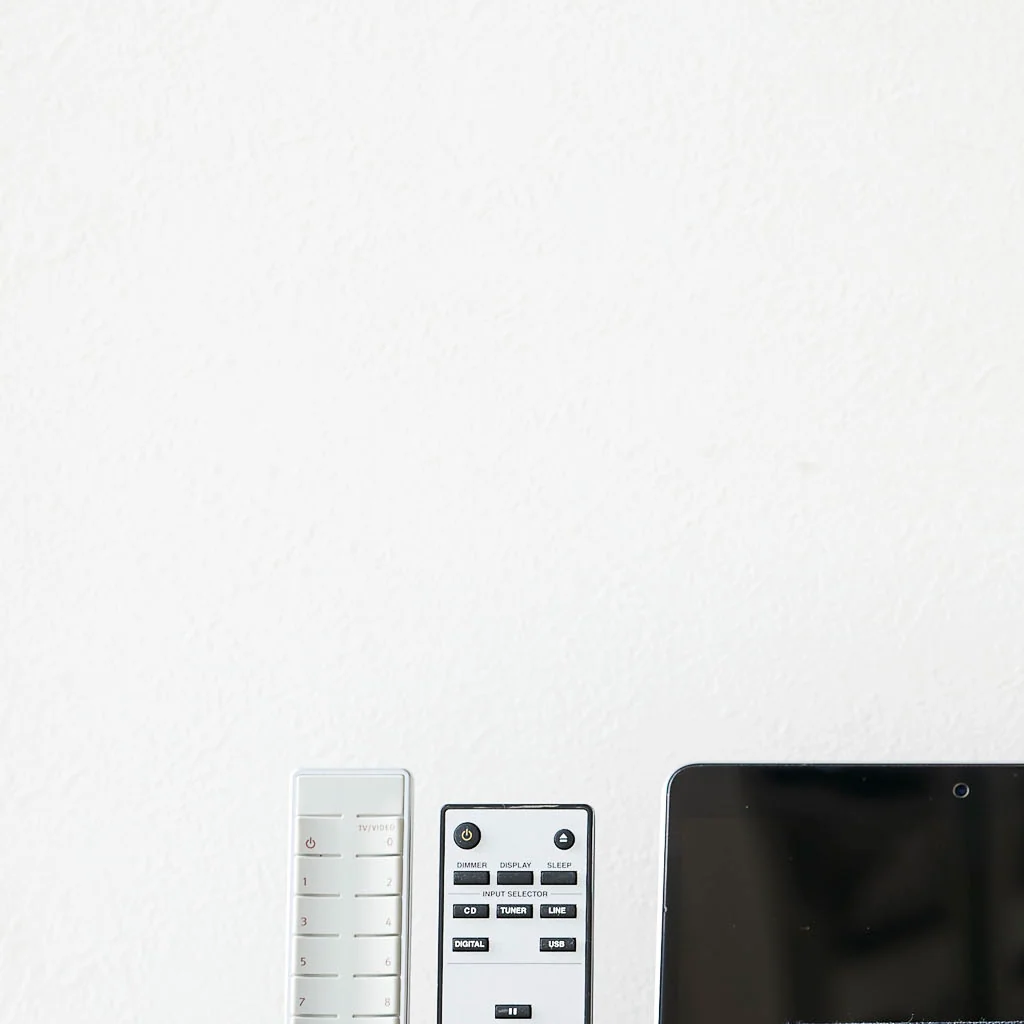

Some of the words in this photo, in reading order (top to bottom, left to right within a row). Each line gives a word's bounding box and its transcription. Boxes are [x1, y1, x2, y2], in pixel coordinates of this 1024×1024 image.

[302, 877, 308, 887] 1
[386, 878, 393, 887] 2
[507, 890, 548, 898] SELECTOR
[463, 906, 477, 915] CD
[500, 906, 527, 915] TUNER
[548, 906, 567, 915] LINE
[301, 917, 308, 926] 3
[385, 917, 392, 927] 4
[454, 940, 485, 948] DIGITAL
[548, 940, 565, 949] USB
[300, 957, 307, 967] 5
[384, 956, 392, 967] 6
[299, 997, 306, 1007] 7
[384, 998, 391, 1007] 8
